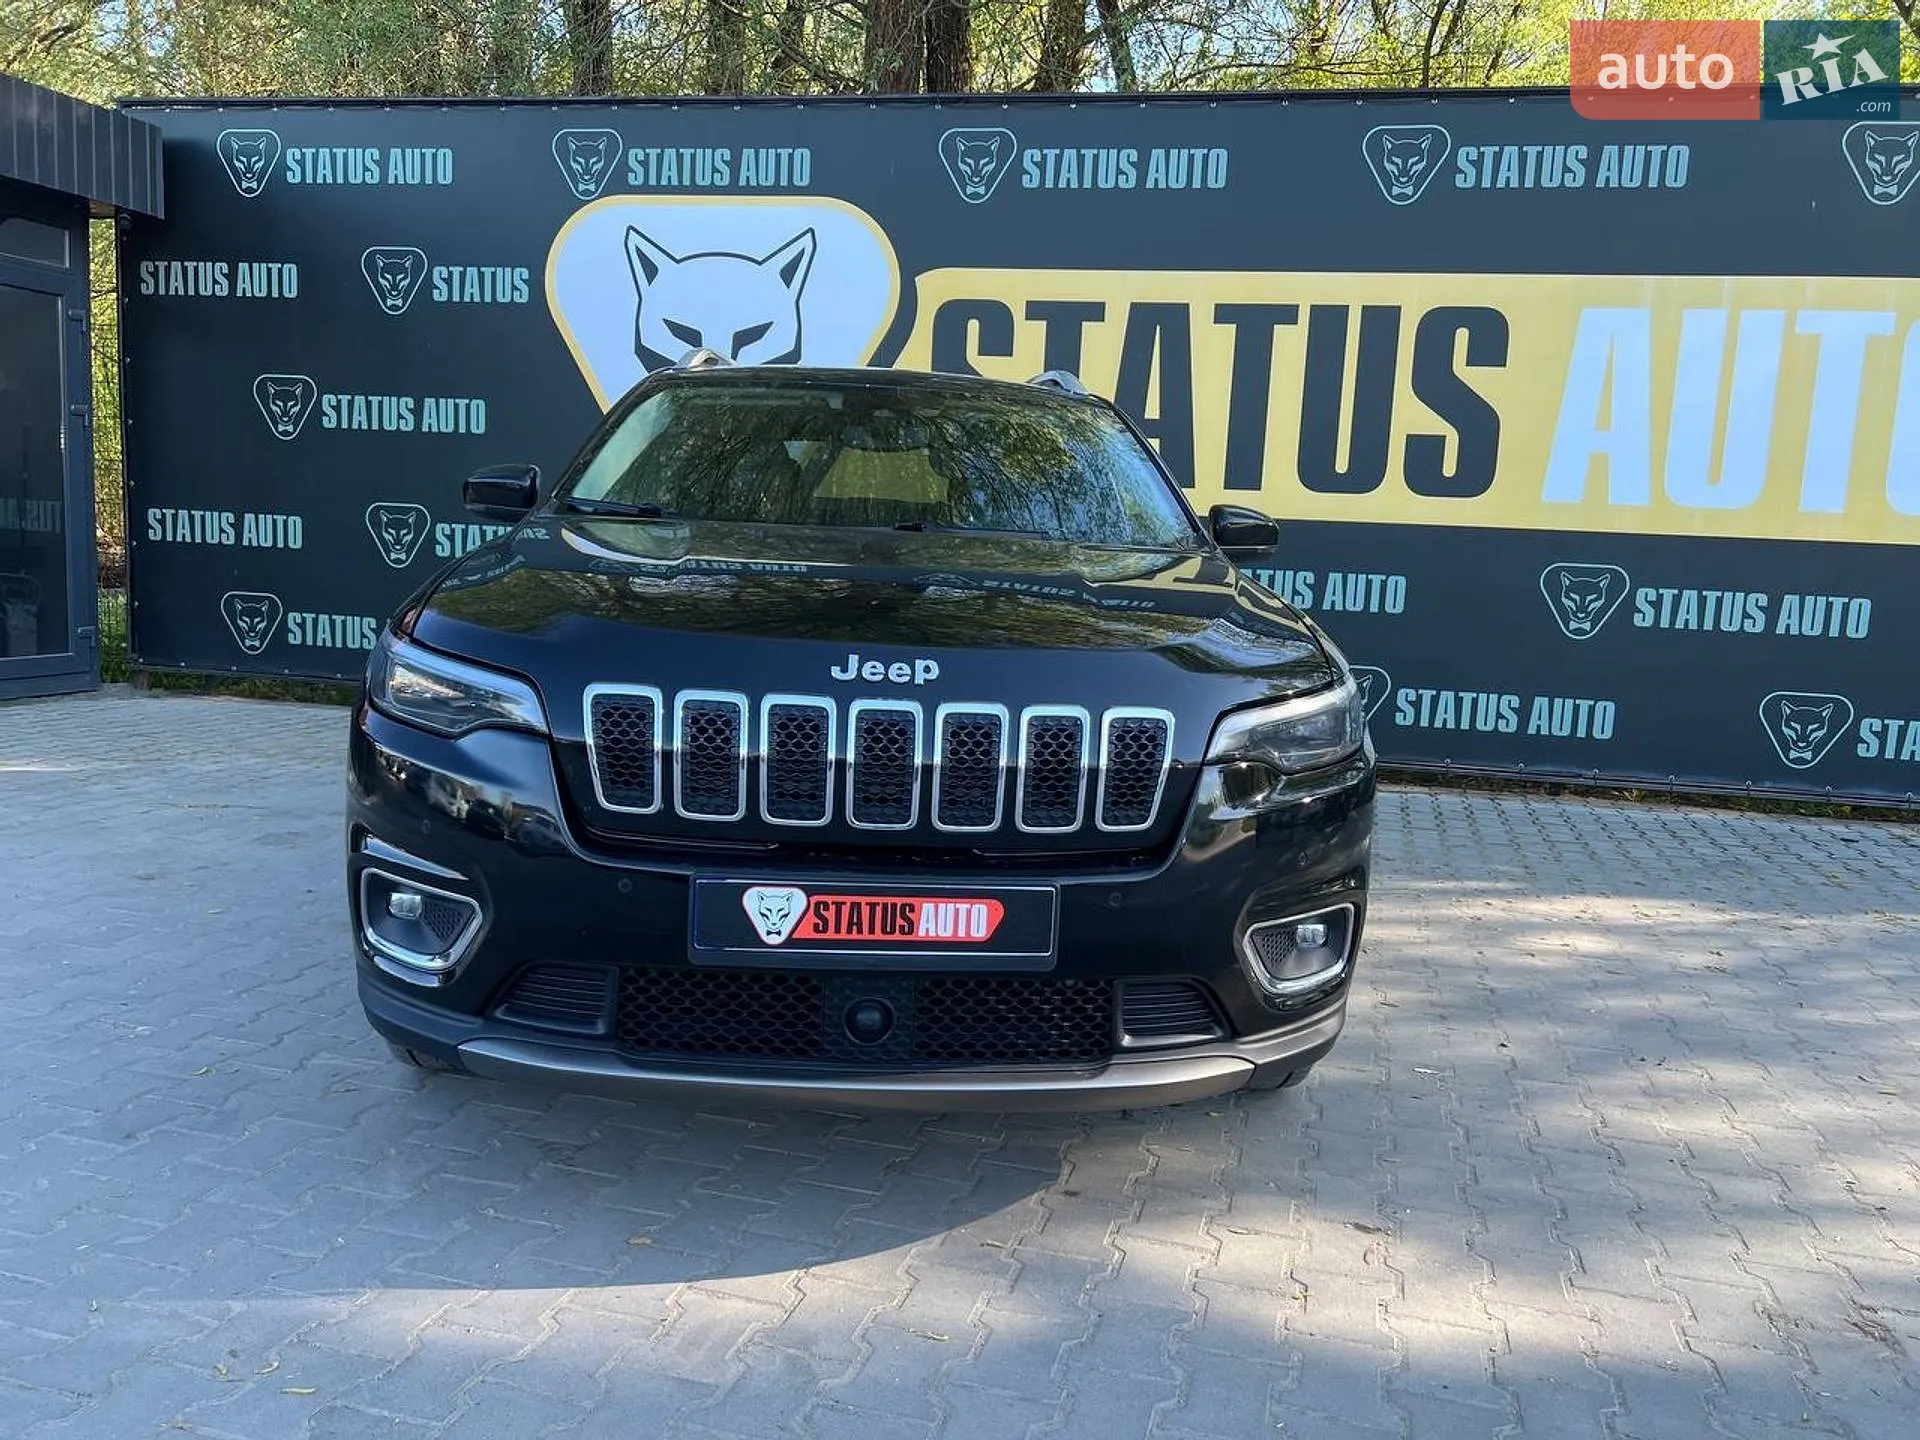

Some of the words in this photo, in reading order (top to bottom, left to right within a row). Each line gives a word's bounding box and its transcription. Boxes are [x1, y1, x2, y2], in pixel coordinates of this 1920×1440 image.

[286, 147, 380, 185] STATUS
[388, 147, 453, 185] AUTO
[627, 148, 731, 186] STATUS
[738, 148, 811, 187] AUTO
[1021, 148, 1138, 189] STATUS
[1145, 148, 1228, 189] AUTO
[1455, 145, 1587, 188] STATUS
[1597, 144, 1690, 188] AUTO
[140, 261, 229, 297] STATUS
[236, 262, 298, 299] AUTO
[432, 266, 529, 303] STATUS
[322, 394, 415, 432] STATUS
[421, 397, 486, 435] AUTO
[1541, 307, 1920, 517] AUT
[147, 508, 236, 545] STATUS
[242, 512, 303, 549] AUTO
[1322, 572, 1407, 614] AUTO
[1633, 587, 1767, 634] STATUS
[1775, 593, 1872, 639] AUTO
[287, 611, 377, 650] STATUS
[830, 654, 940, 685] Jeep
[1395, 687, 1519, 734] STATUS
[1527, 694, 1616, 740] AUTO
